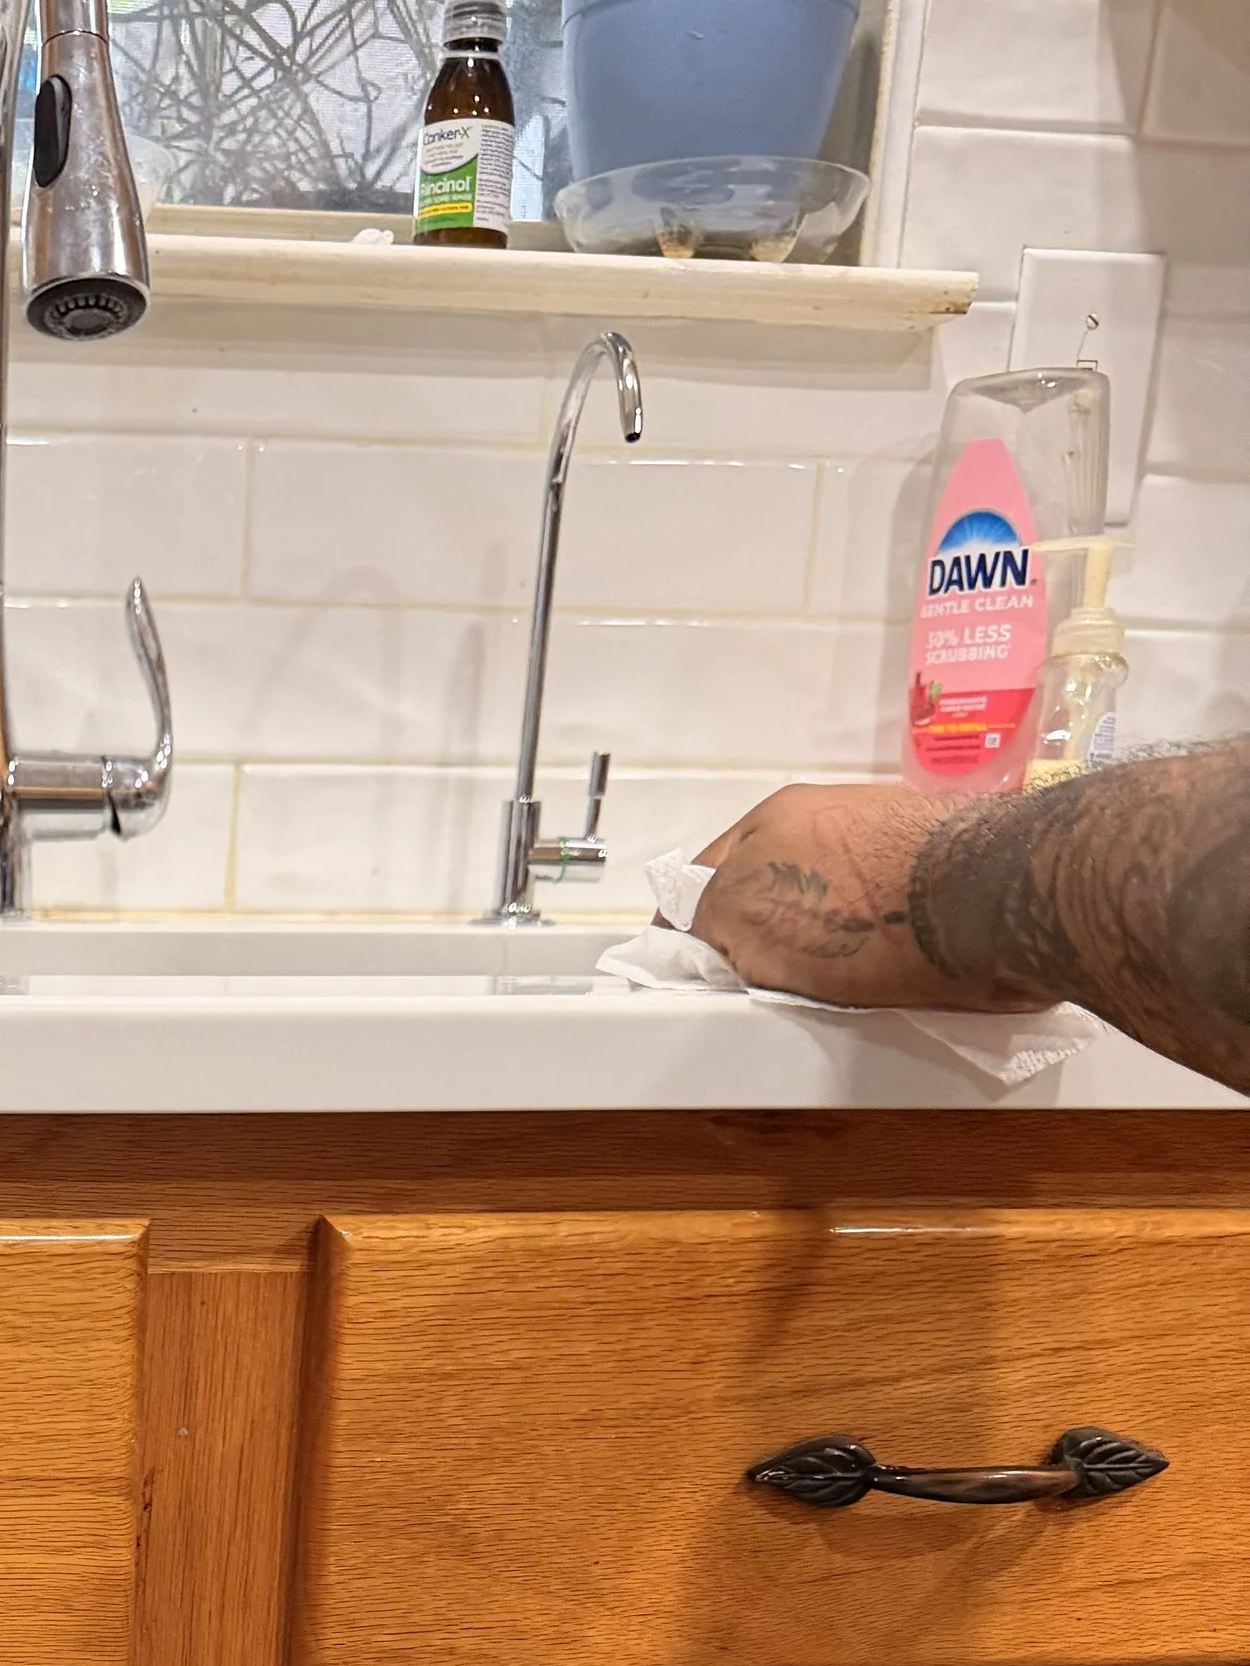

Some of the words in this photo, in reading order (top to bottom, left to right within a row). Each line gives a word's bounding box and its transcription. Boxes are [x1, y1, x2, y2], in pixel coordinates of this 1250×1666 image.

[423, 126, 470, 146] Canker-X
[928, 549, 1029, 596] DAWN
[974, 595, 1034, 612] CLEAN
[963, 623, 1012, 645] LESS
